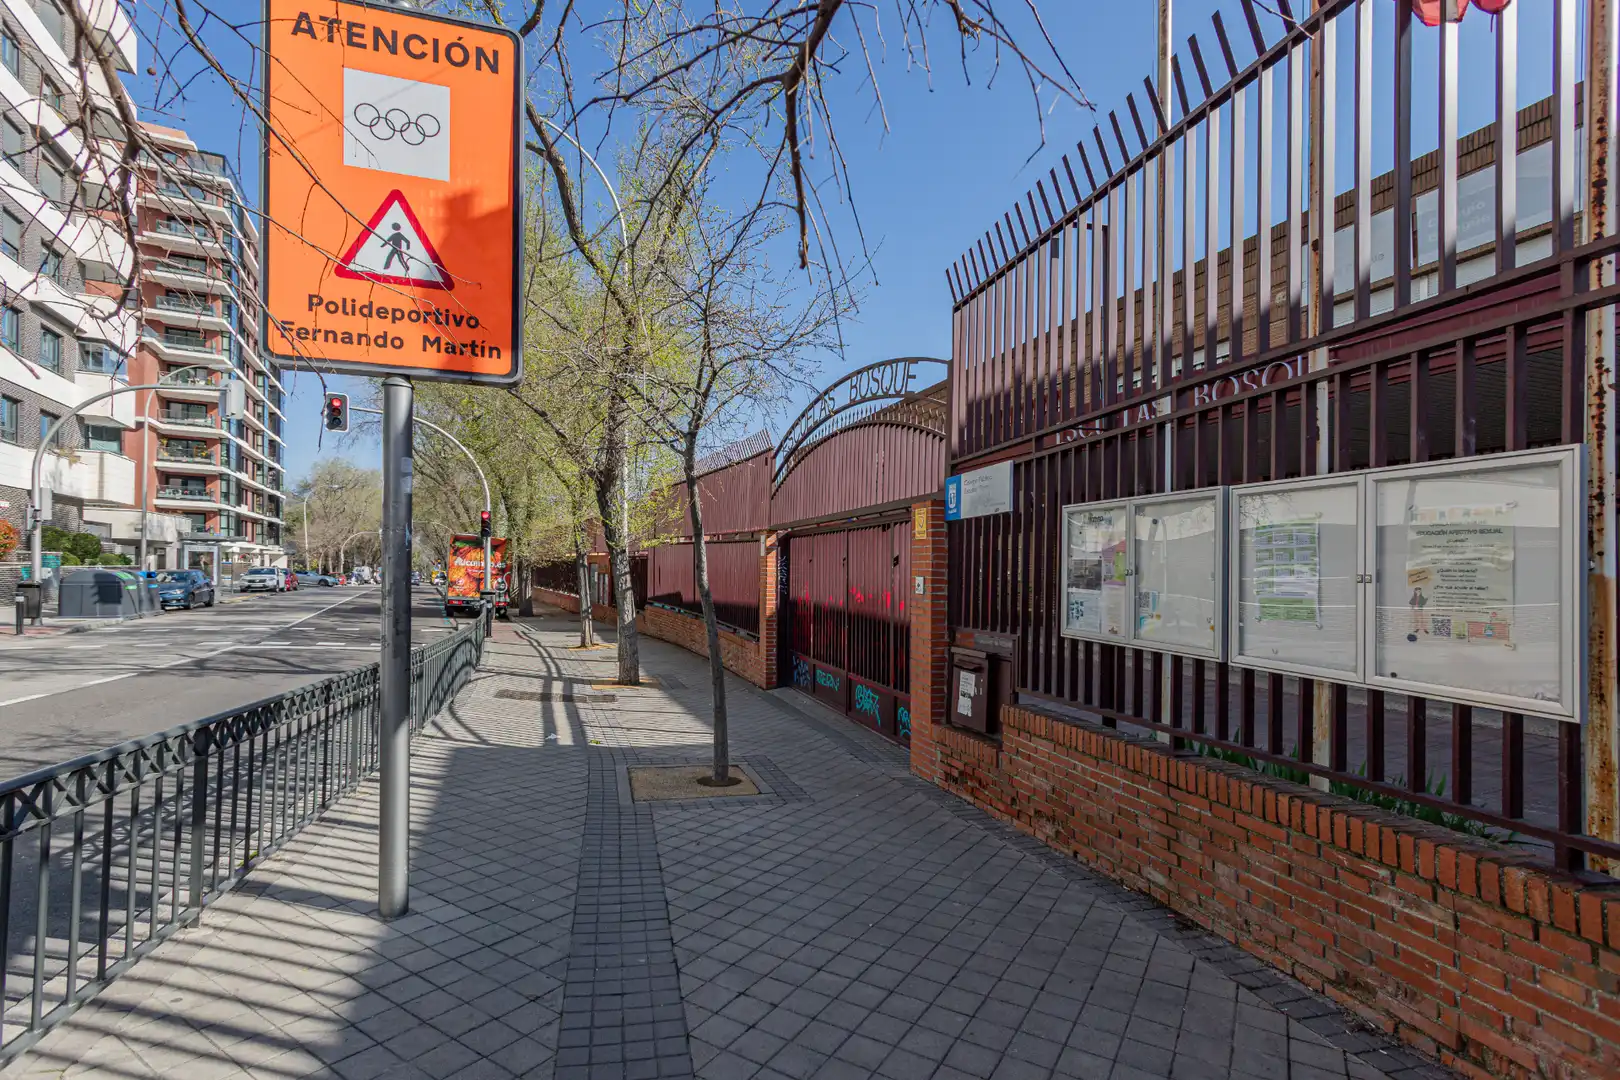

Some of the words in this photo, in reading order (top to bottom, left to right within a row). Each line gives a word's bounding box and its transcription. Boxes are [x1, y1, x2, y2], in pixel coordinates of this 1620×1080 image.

[291, 12, 500, 75] ATENCIÓN
[307, 293, 480, 329] Polideportivo
[280, 320, 404, 351] Fernando
[422, 334, 502, 360] Martín
[849, 361, 919, 401] BOSQUE
